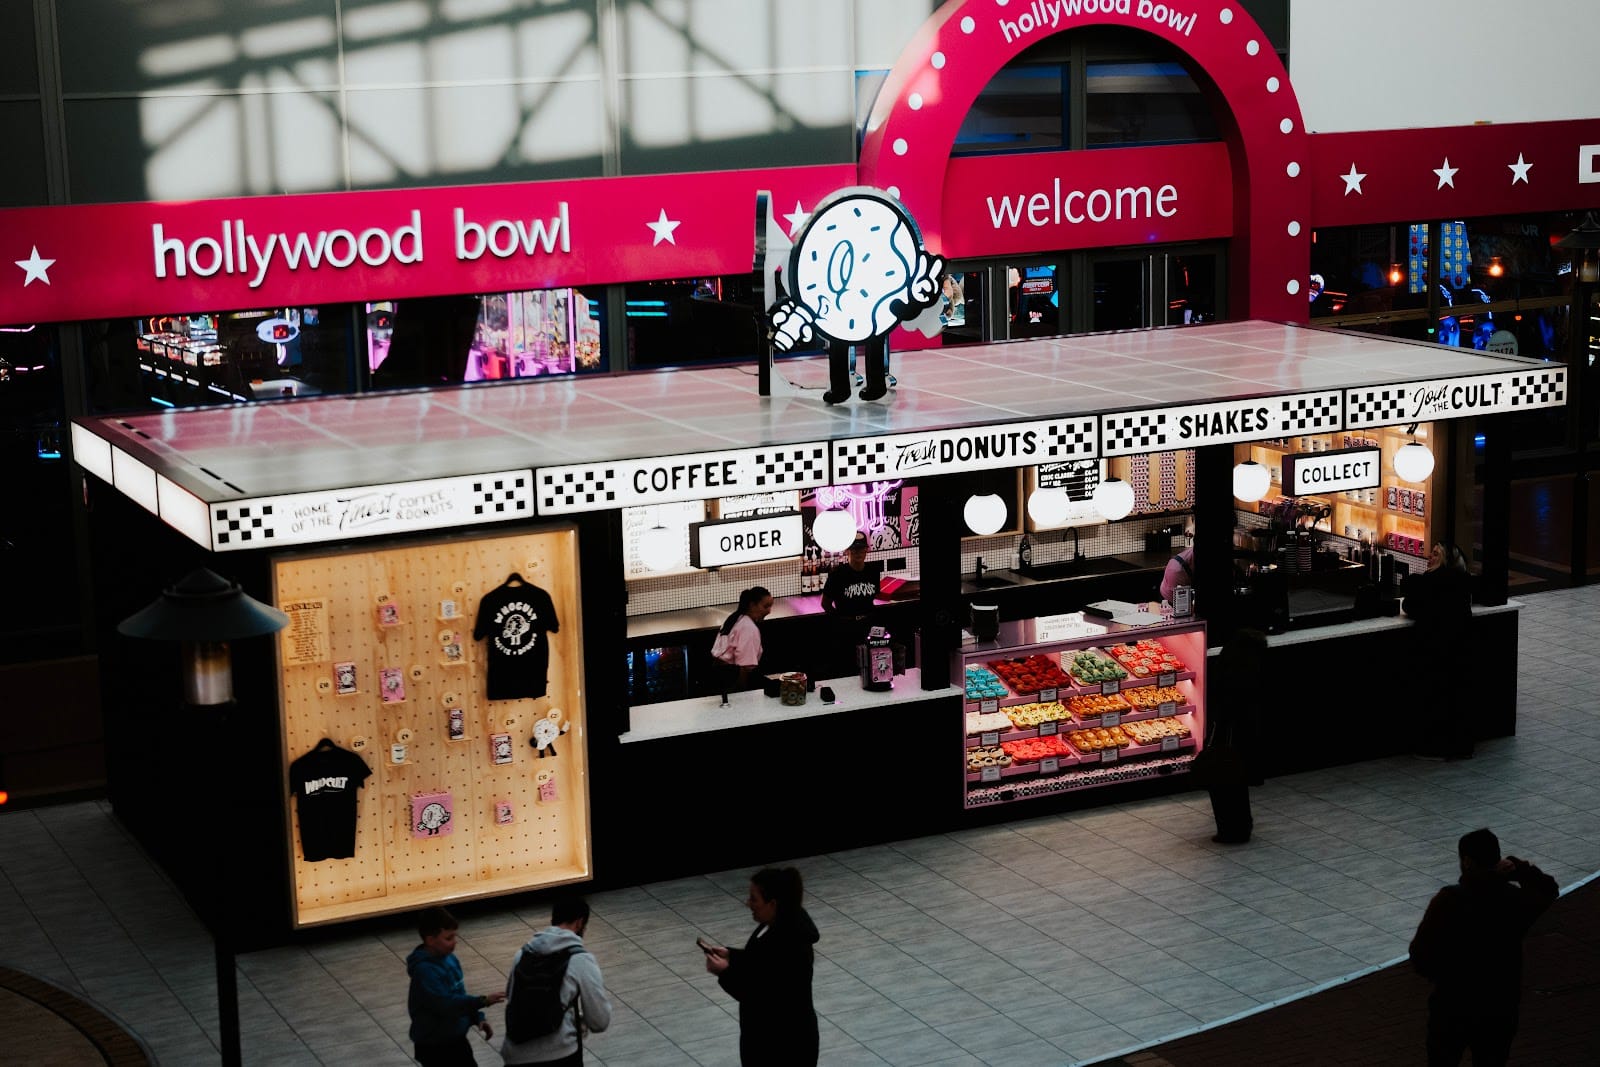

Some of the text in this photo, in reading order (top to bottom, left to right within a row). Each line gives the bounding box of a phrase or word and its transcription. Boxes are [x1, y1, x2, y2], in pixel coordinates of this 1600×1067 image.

[999, 0, 1198, 43] hollywood bowl
[986, 178, 1179, 229] welcome
[152, 201, 571, 289] hollywood bowl
[1412, 382, 1503, 418] Join THE CULT
[1178, 407, 1269, 440] SHAKES
[894, 430, 1038, 471] Fresh DONUTS
[633, 459, 738, 494] COFFEE
[1302, 461, 1371, 484] COLLECT
[294, 502, 330, 519] HOME
[398, 489, 446, 508] COFFEE
[290, 515, 334, 534] OF THE
[720, 529, 783, 554] ORDER
